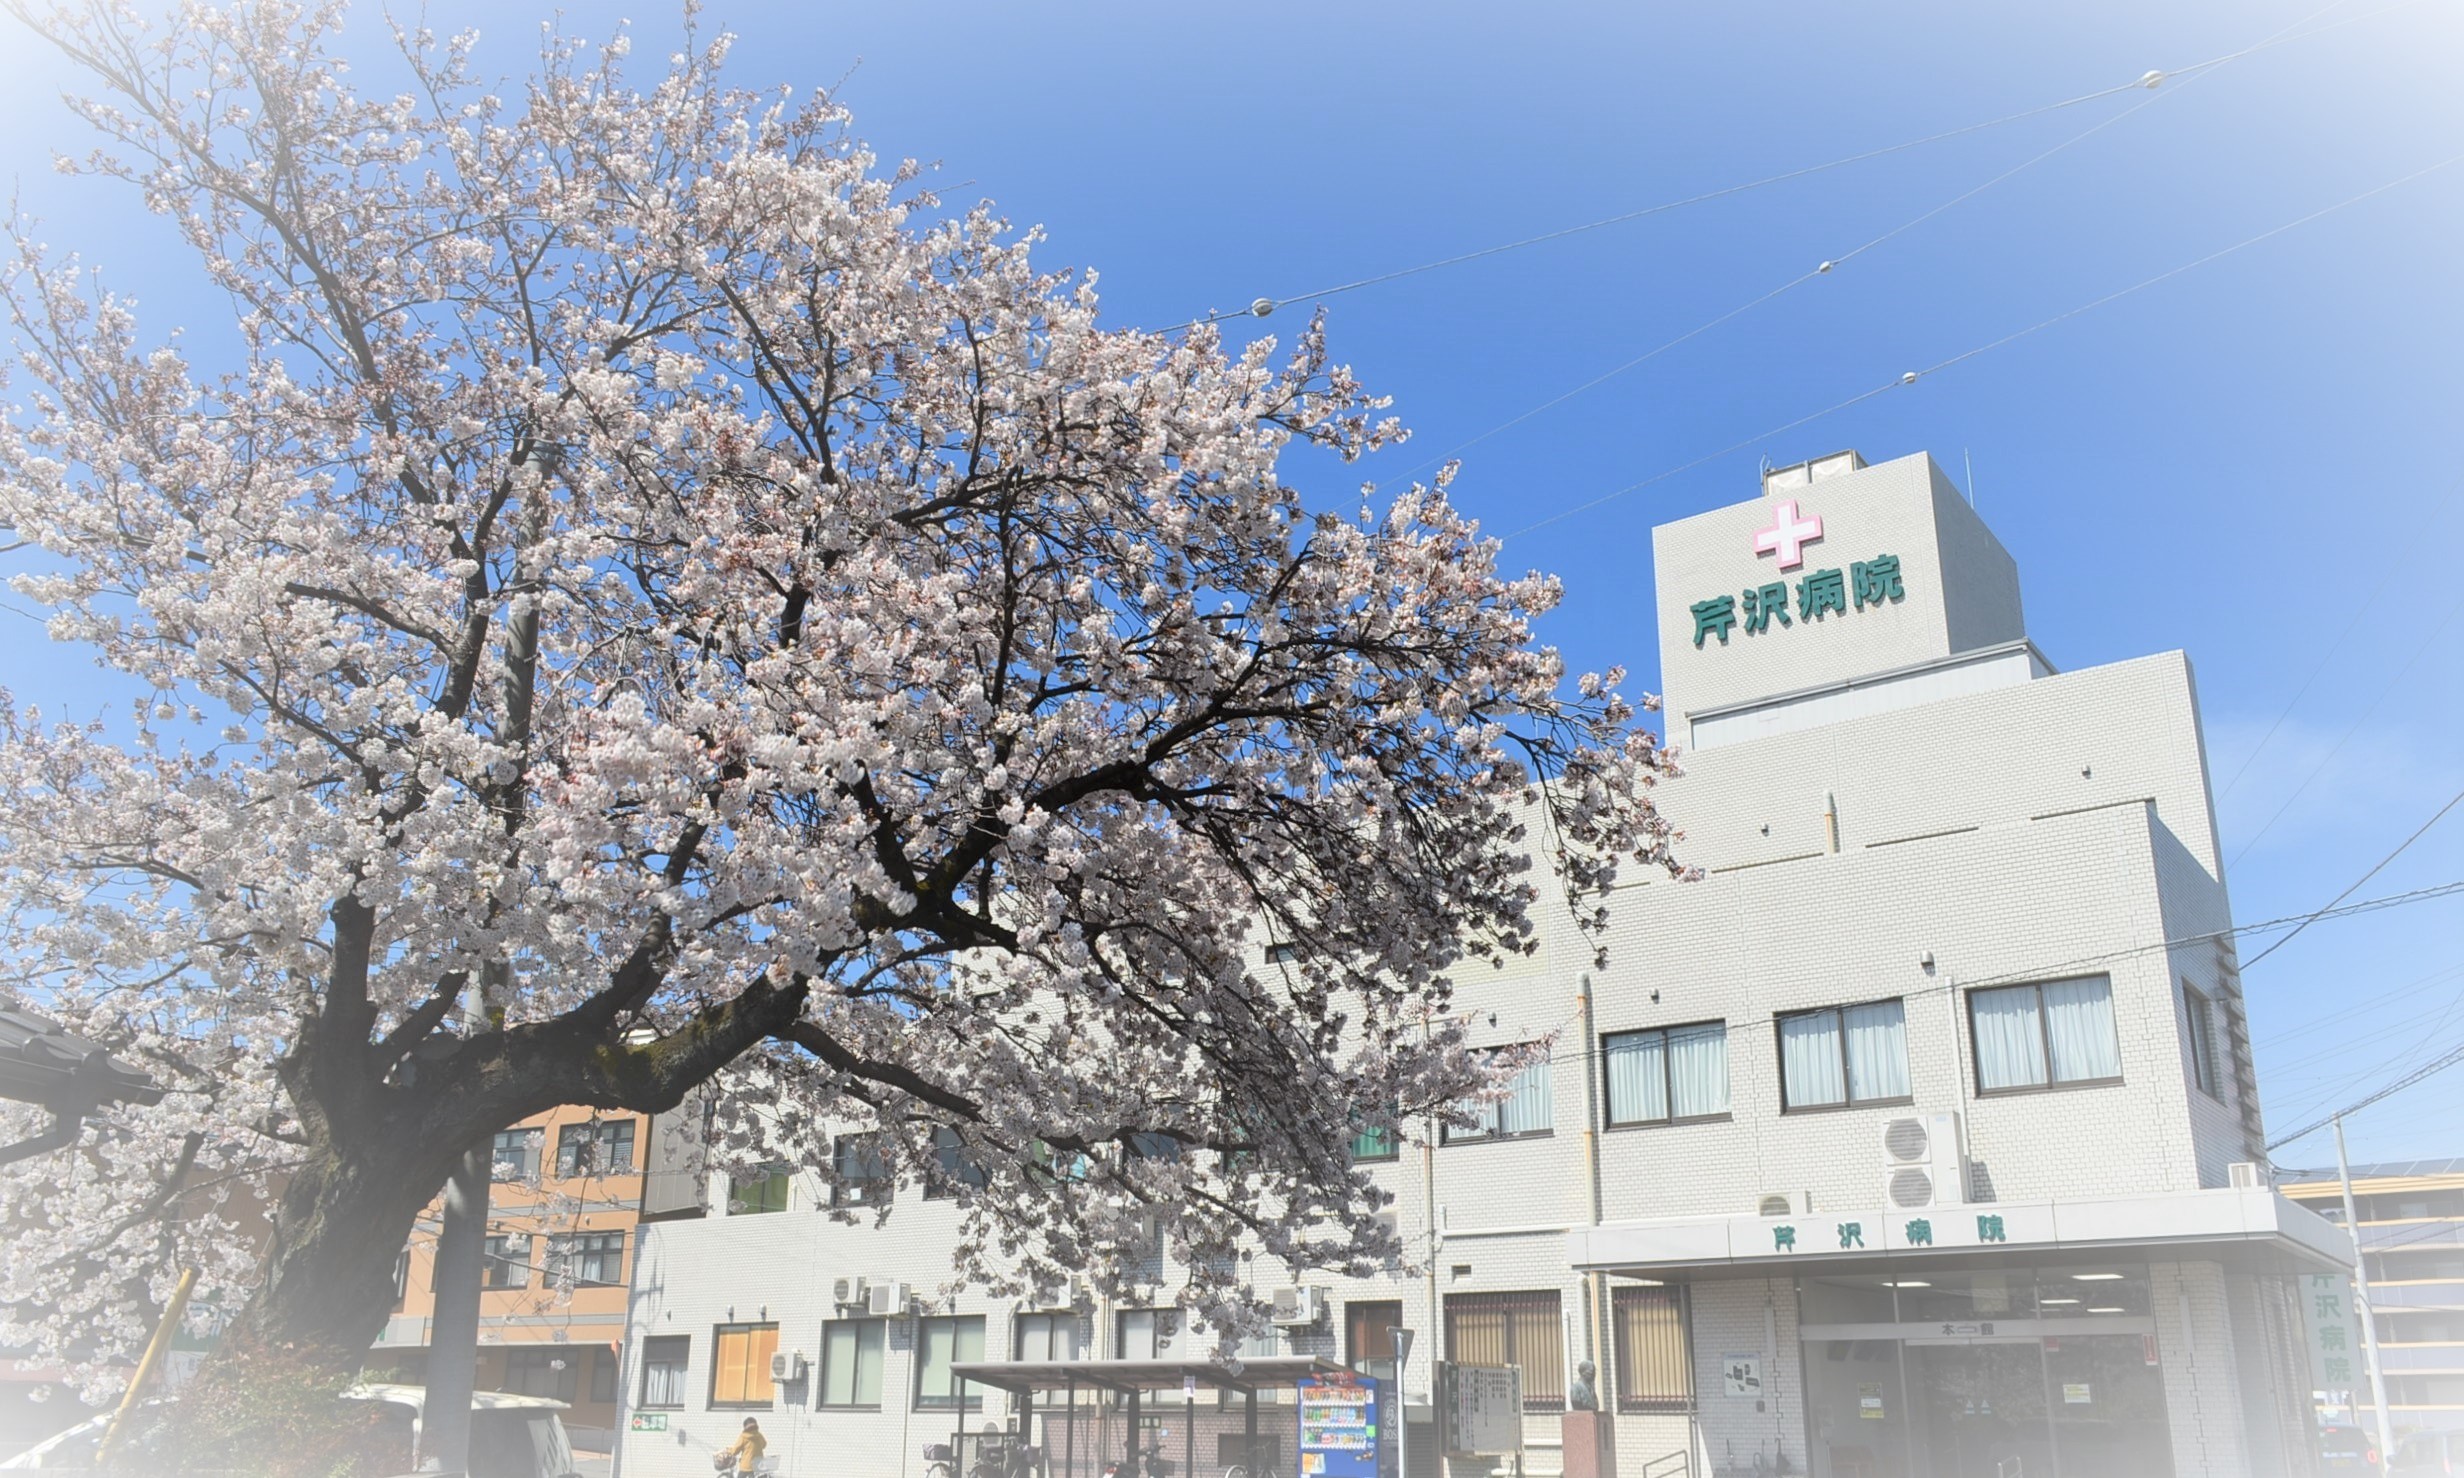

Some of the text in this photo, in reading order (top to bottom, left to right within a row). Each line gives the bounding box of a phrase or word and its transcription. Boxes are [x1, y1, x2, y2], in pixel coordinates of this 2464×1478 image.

[1690, 554, 1904, 645] 芹沢病院
[1773, 1215, 2006, 1252] 芹沢病院
